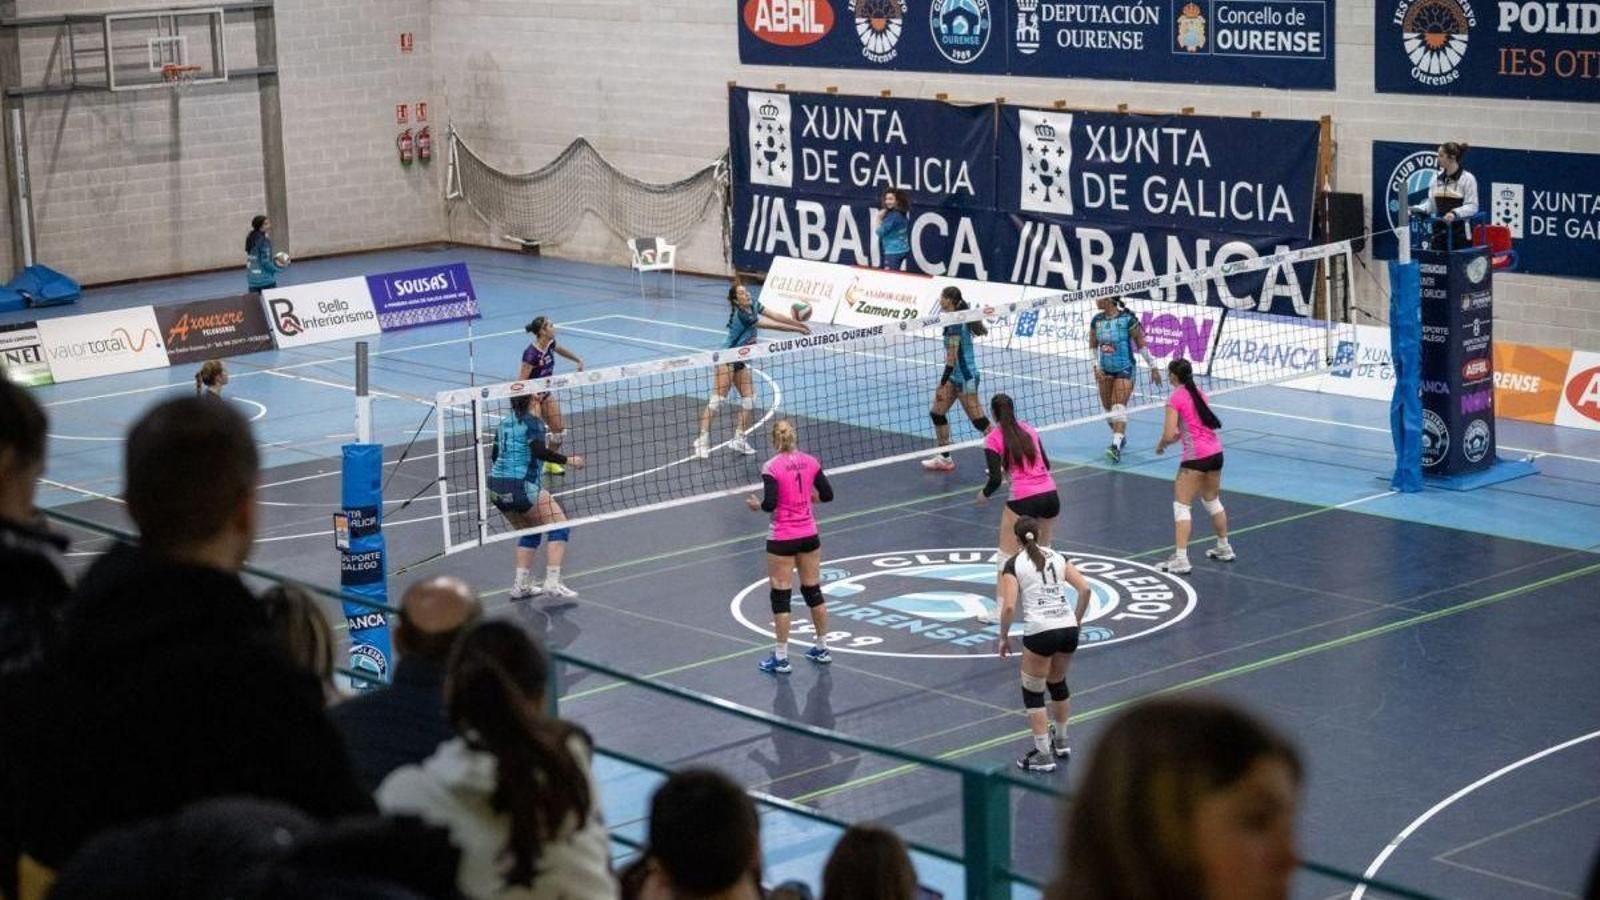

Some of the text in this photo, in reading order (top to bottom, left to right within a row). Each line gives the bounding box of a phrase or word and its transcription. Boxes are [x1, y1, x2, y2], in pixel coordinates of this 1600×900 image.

[754, 0, 825, 34] ABRIL
[1041, 1, 1160, 26] DEPUTACIÓN
[1217, 6, 1306, 26] Concello de
[942, 35, 980, 45] OURENSE
[1057, 28, 1144, 50] OURENSE
[1217, 29, 1321, 52] OURENSE
[1498, 49, 1600, 78] IES OT
[1411, 68, 1460, 86] Ourense
[801, 104, 908, 145] XUNTA
[1085, 124, 1212, 169] XUNTA
[802, 148, 975, 196] DE GALICIA
[1082, 172, 1296, 224] DE GALICIA
[1531, 216, 1557, 236] DE
[394, 273, 448, 296] SOUSAS
[318, 299, 349, 314] Bello
[1062, 291, 1084, 303] CLUB
[301, 308, 374, 330] Interiorismo
[855, 301, 900, 318] Zamora
[902, 307, 918, 320] 99
[769, 326, 883, 353] CLUB VOLEIBOL OURENSE
[1422, 325, 1449, 335] EPORTE
[1423, 334, 1446, 343] ALEGO
[1364, 347, 1392, 363] XUN
[1421, 381, 1449, 394] ANCA
[1493, 371, 1542, 393] RENSE
[795, 472, 803, 494] 1
[351, 517, 378, 528] ALICIA
[1072, 558, 1174, 620] OLEIBOL
[350, 613, 385, 629] ANCA
[790, 594, 1003, 648] URENSE
